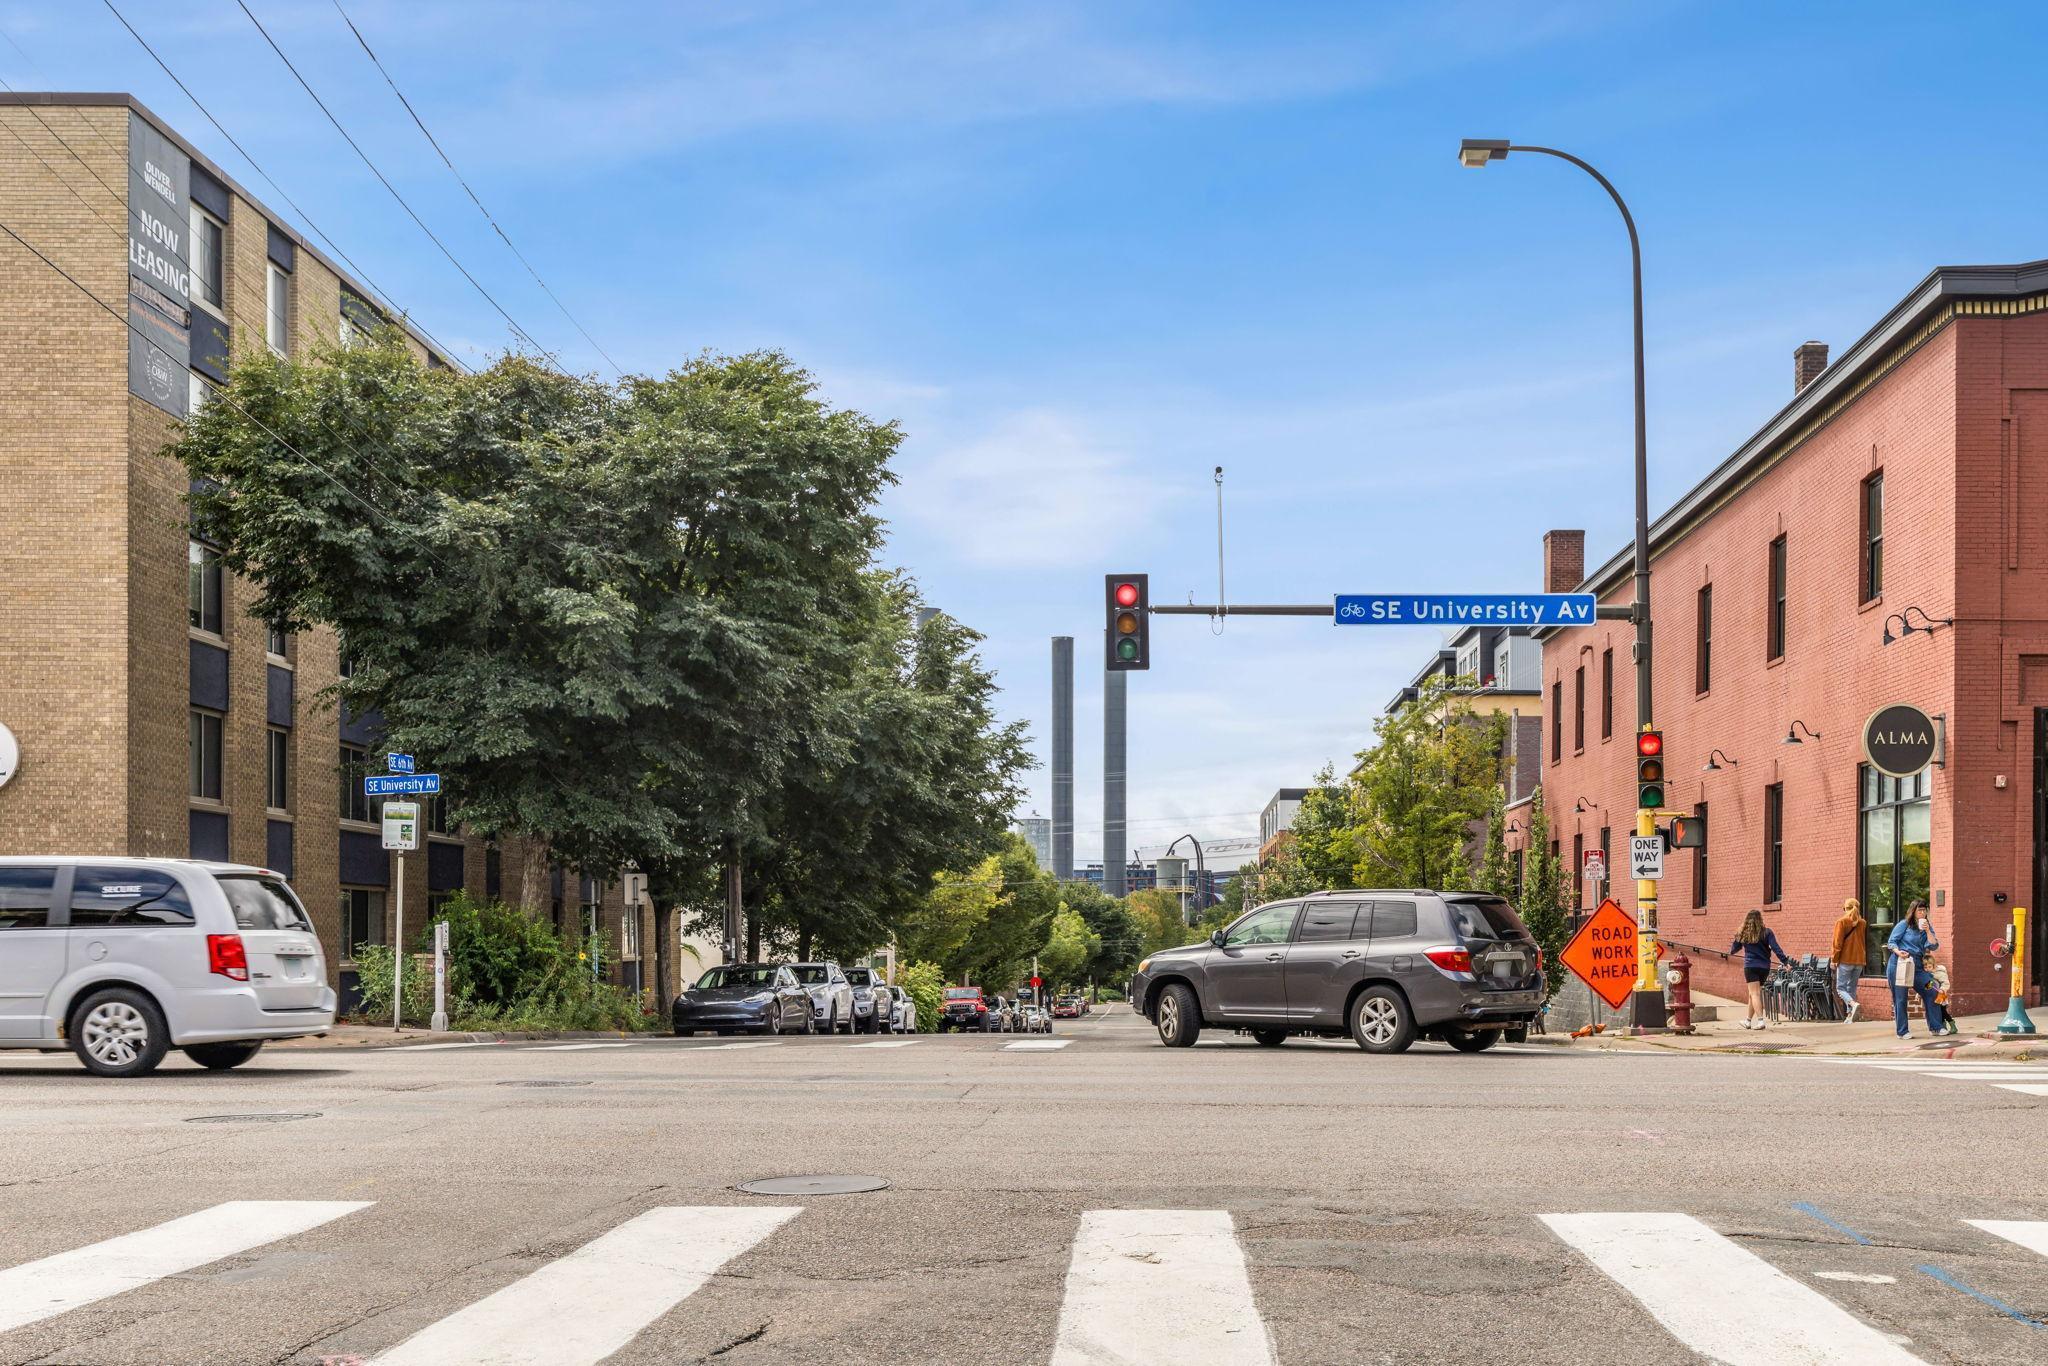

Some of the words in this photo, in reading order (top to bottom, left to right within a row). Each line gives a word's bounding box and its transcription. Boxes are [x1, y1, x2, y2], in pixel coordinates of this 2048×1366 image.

[145, 161, 171, 188] OLIVER
[144, 170, 176, 205] WENDELL
[141, 209, 179, 253] NOW
[129, 237, 188, 298] LEASING
[1371, 601, 1401, 619] SE
[1413, 600, 1545, 623] University
[1557, 600, 1589, 619] Av
[1874, 731, 1929, 745] ALMA
[390, 756, 396, 768] SE
[398, 758, 406, 769] 6th
[368, 781, 379, 792] SE
[381, 779, 423, 792] University
[426, 778, 436, 789] Av
[1635, 839, 1659, 850] ONE
[1634, 851, 1659, 862] WAY
[1591, 926, 1632, 942] ROAD
[1592, 945, 1634, 960] WORK
[1590, 963, 1638, 979] AHEAD
